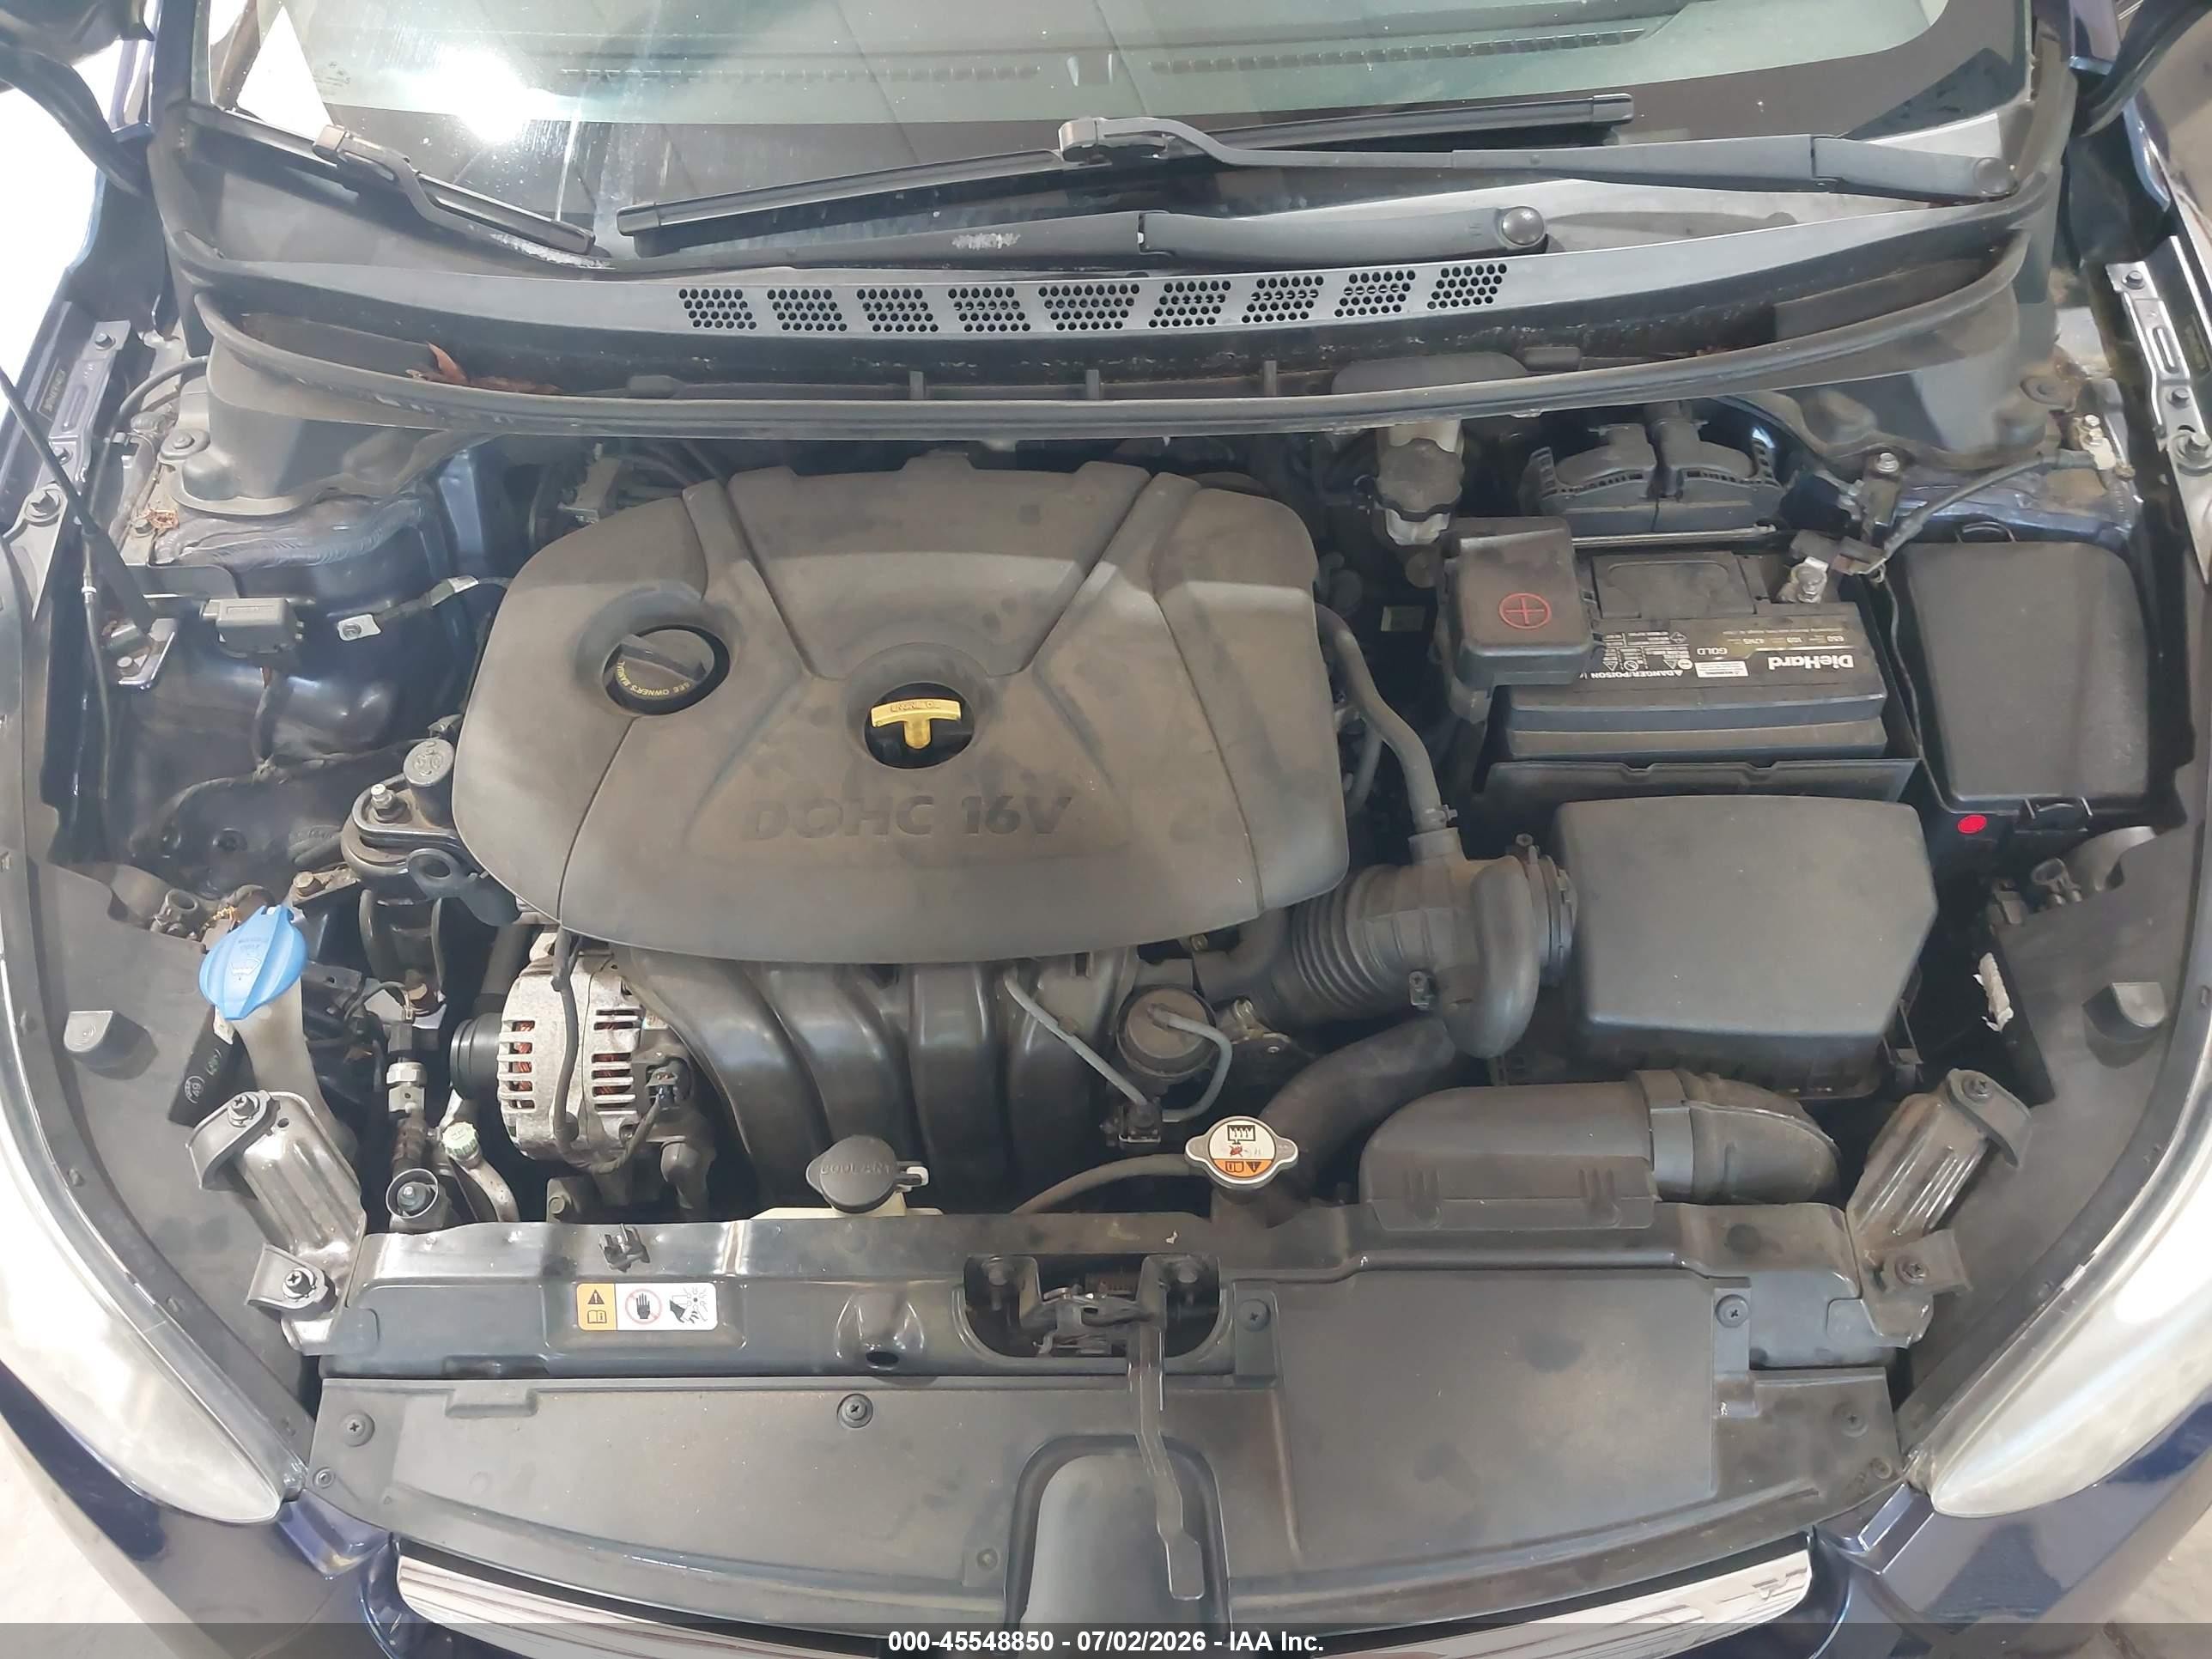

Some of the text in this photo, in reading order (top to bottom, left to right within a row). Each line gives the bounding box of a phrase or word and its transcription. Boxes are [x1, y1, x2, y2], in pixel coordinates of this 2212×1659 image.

[1696, 647, 1728, 655] GOLD
[1767, 654, 1855, 671] DieHard
[616, 660, 690, 696] SEE OWNER'S MANUAL
[1590, 670, 1674, 679] DANGER/POISON
[744, 795, 1073, 841] DOHC 16V
[820, 1160, 892, 1176] COOLANT
